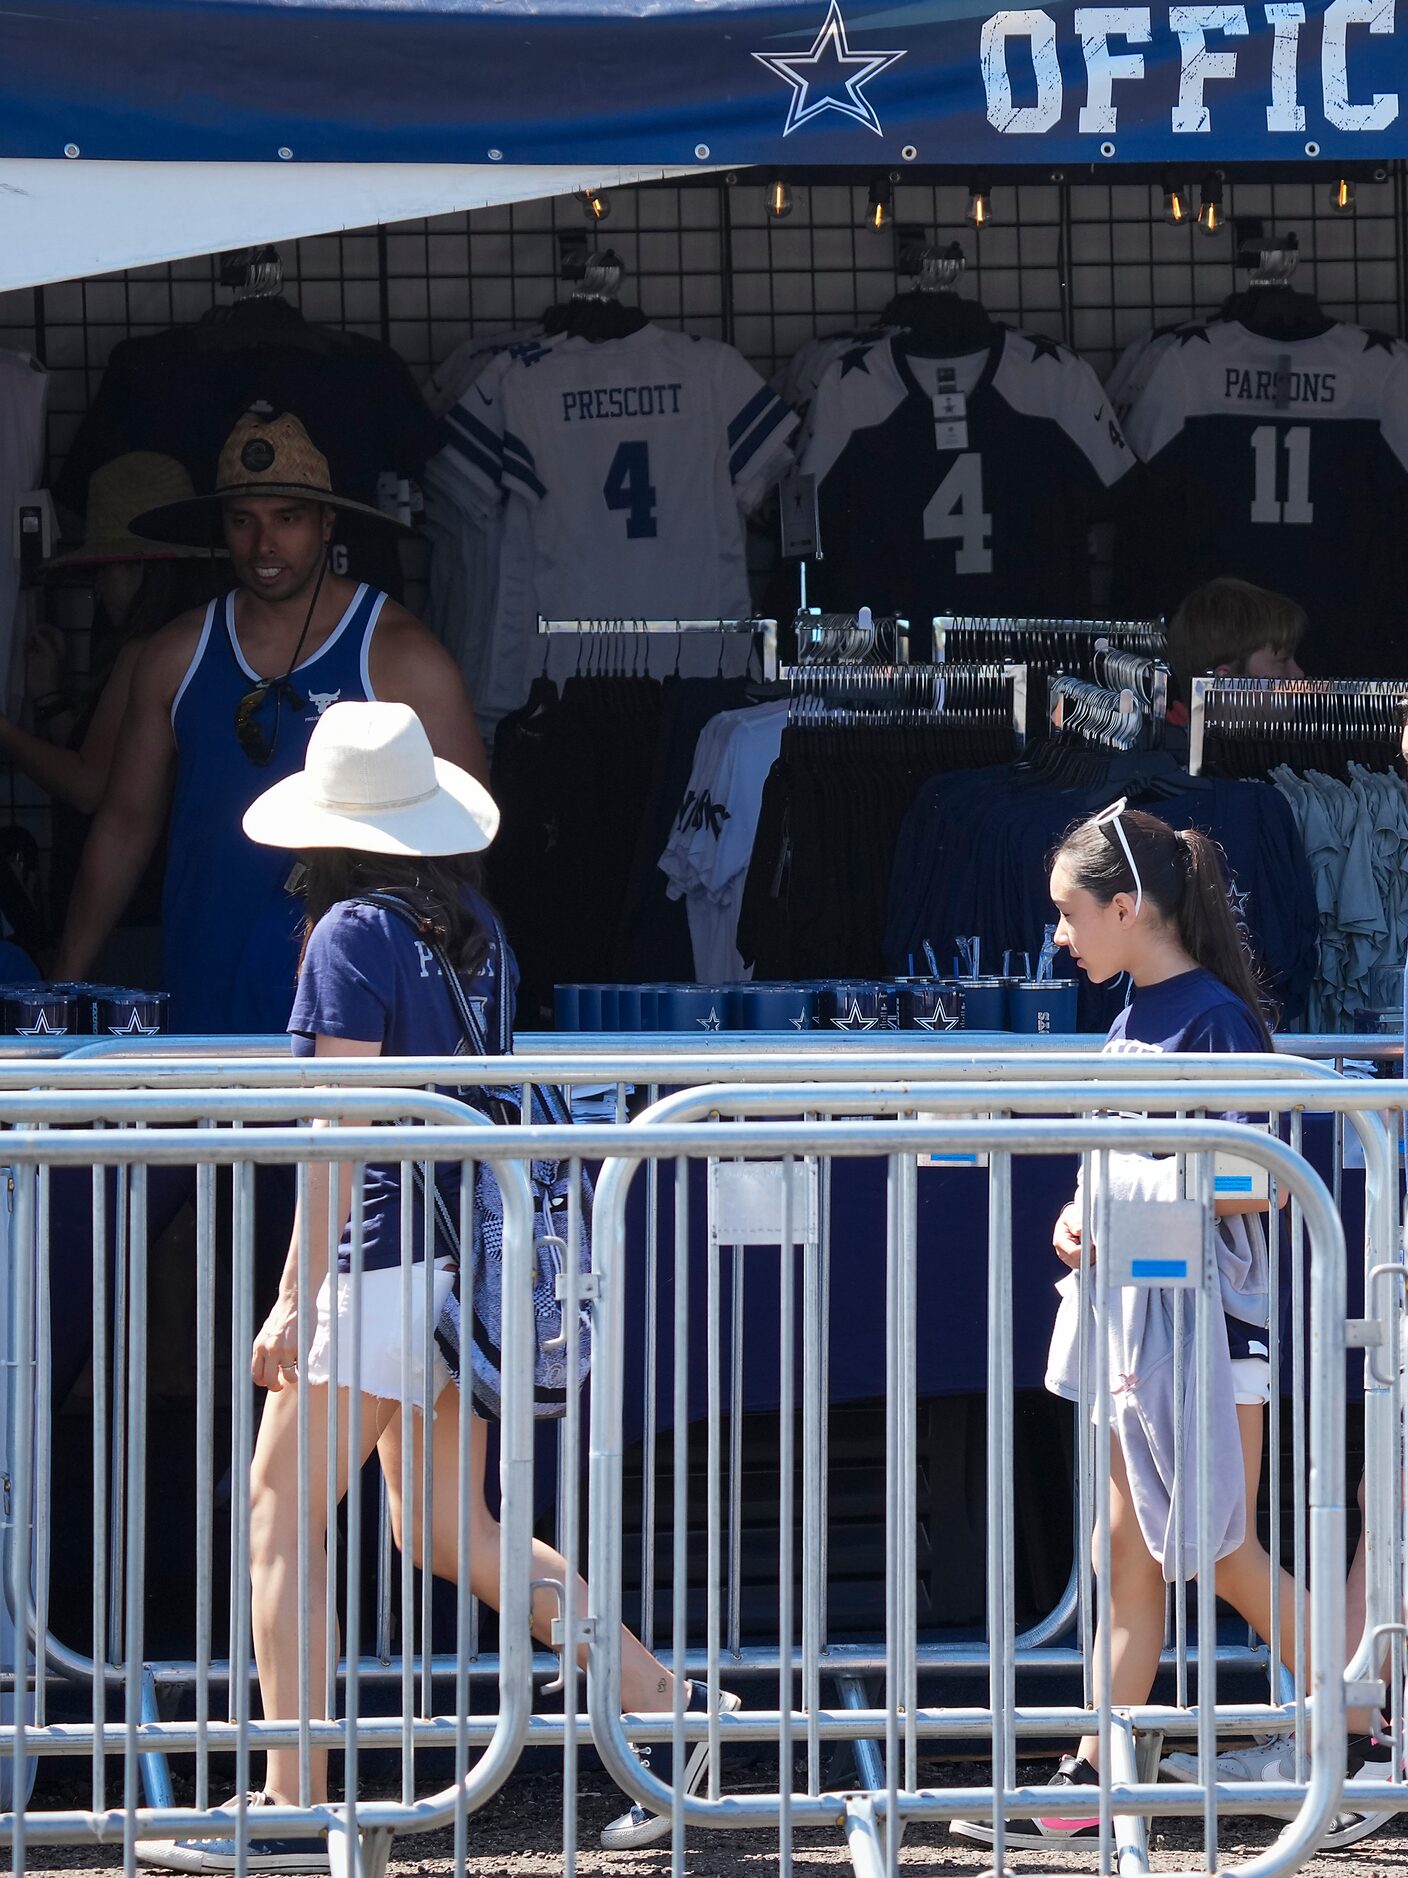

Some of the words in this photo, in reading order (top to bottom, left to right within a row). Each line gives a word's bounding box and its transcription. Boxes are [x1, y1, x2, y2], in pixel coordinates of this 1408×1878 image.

[562, 383, 682, 422] PRESCOTT
[603, 440, 658, 539] 4
[922, 452, 994, 575] 4
[1250, 424, 1314, 524] 11
